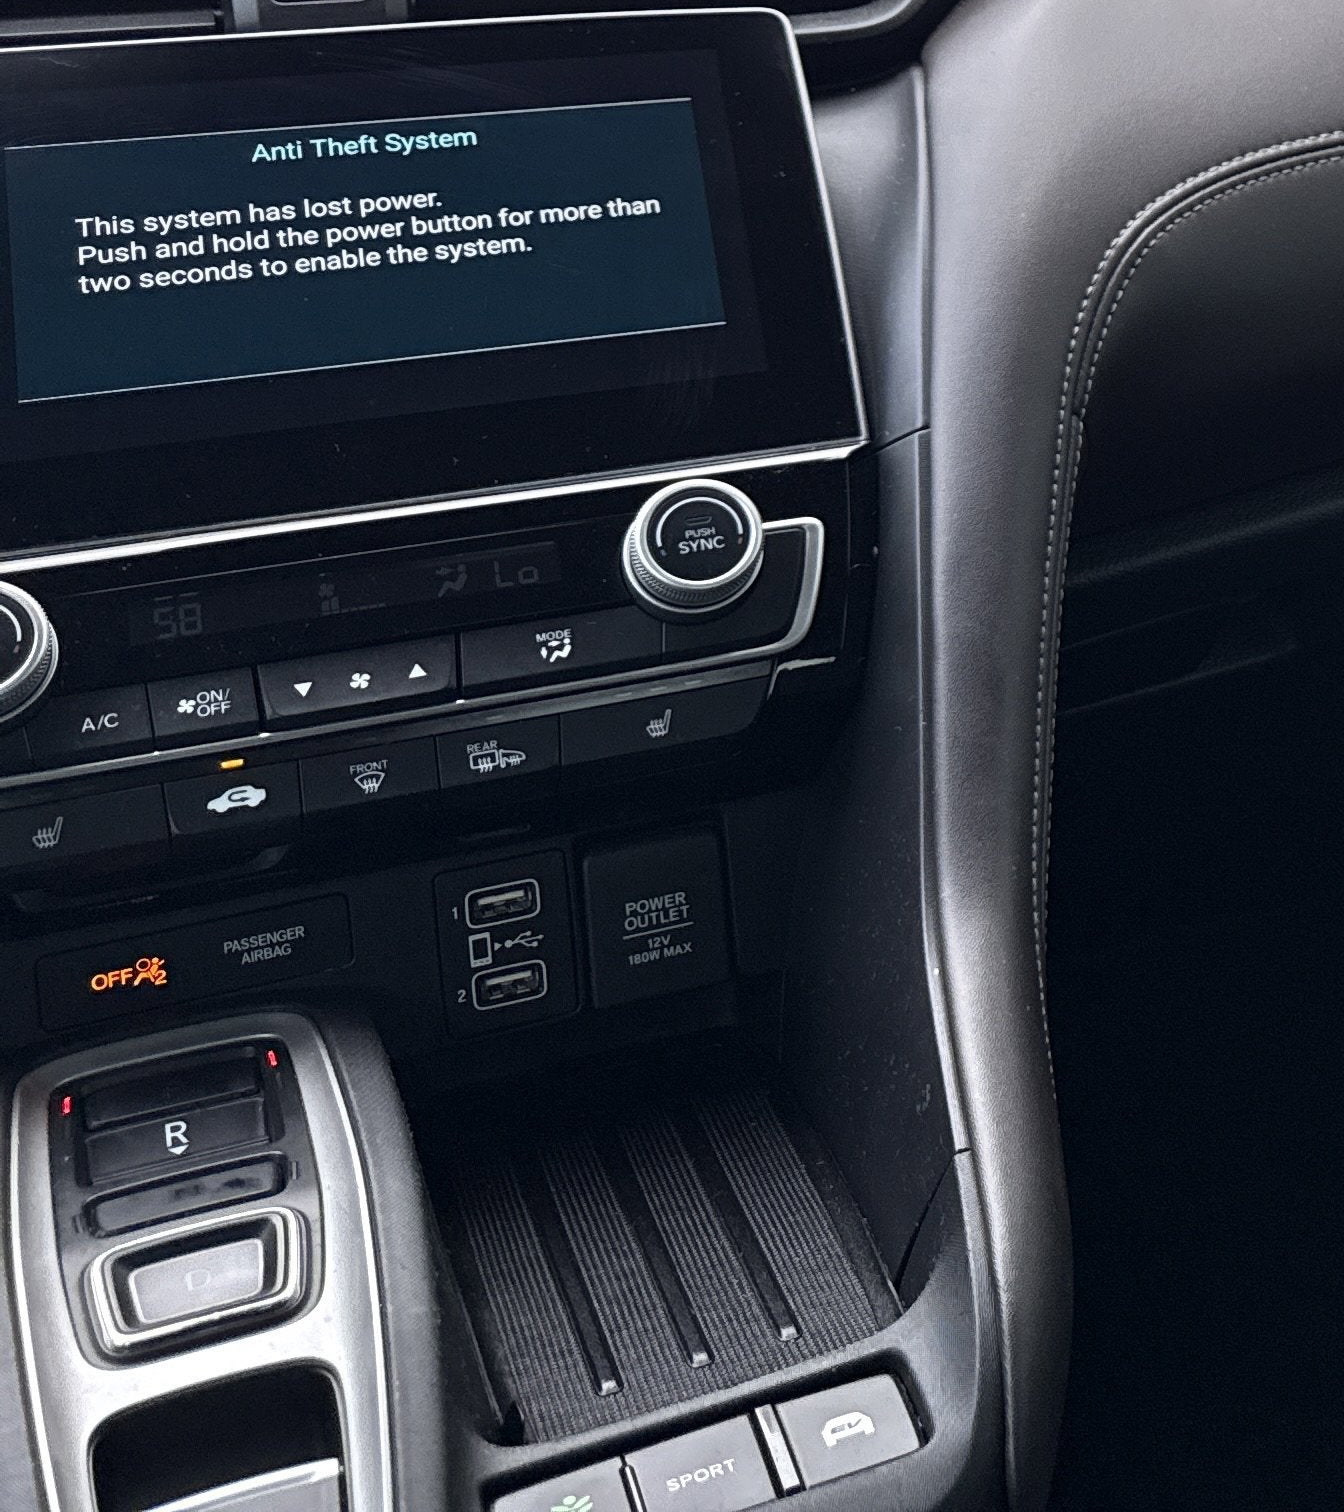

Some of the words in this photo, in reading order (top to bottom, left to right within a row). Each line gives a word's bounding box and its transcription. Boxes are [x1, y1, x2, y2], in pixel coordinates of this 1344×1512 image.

[252, 141, 302, 162] Anti
[309, 134, 378, 159] Theft
[384, 130, 478, 156] System
[75, 216, 135, 237] This
[143, 208, 241, 236] system
[248, 202, 296, 223] has
[303, 197, 352, 219] lost
[359, 191, 443, 218] power.
[78, 240, 147, 266] Push
[155, 235, 205, 259] and
[213, 230, 269, 254] hold
[276, 226, 319, 248] the
[326, 220, 404, 248] power
[411, 212, 493, 236] button
[498, 206, 534, 228] for
[539, 202, 602, 224] more
[606, 196, 661, 218] than
[77, 274, 131, 294] two
[139, 259, 253, 289] seconds
[260, 257, 288, 277] to
[295, 247, 381, 274] enable
[386, 244, 428, 265] the
[434, 236, 532, 264] system.
[684, 526, 716, 539] PUSH
[678, 536, 726, 555] SYNC
[535, 628, 571, 643] MODE
[196, 688, 231, 703] ON/
[196, 701, 231, 717] OFF
[81, 712, 119, 733] A/C
[466, 740, 498, 754] REAR
[350, 759, 388, 775] FRONT
[451, 906, 459, 920] 1
[625, 891, 686, 917] POWER
[624, 904, 691, 932] OUTLET
[223, 925, 305, 954] PASSENGER
[647, 934, 671, 949] 12V
[241, 943, 292, 965] AIRBAG
[628, 950, 661, 966] 180W
[663, 942, 693, 958] MAX
[90, 968, 133, 991] OFF
[457, 989, 467, 1003] 2
[164, 1120, 190, 1149] R
[665, 1458, 735, 1492] SPORT
